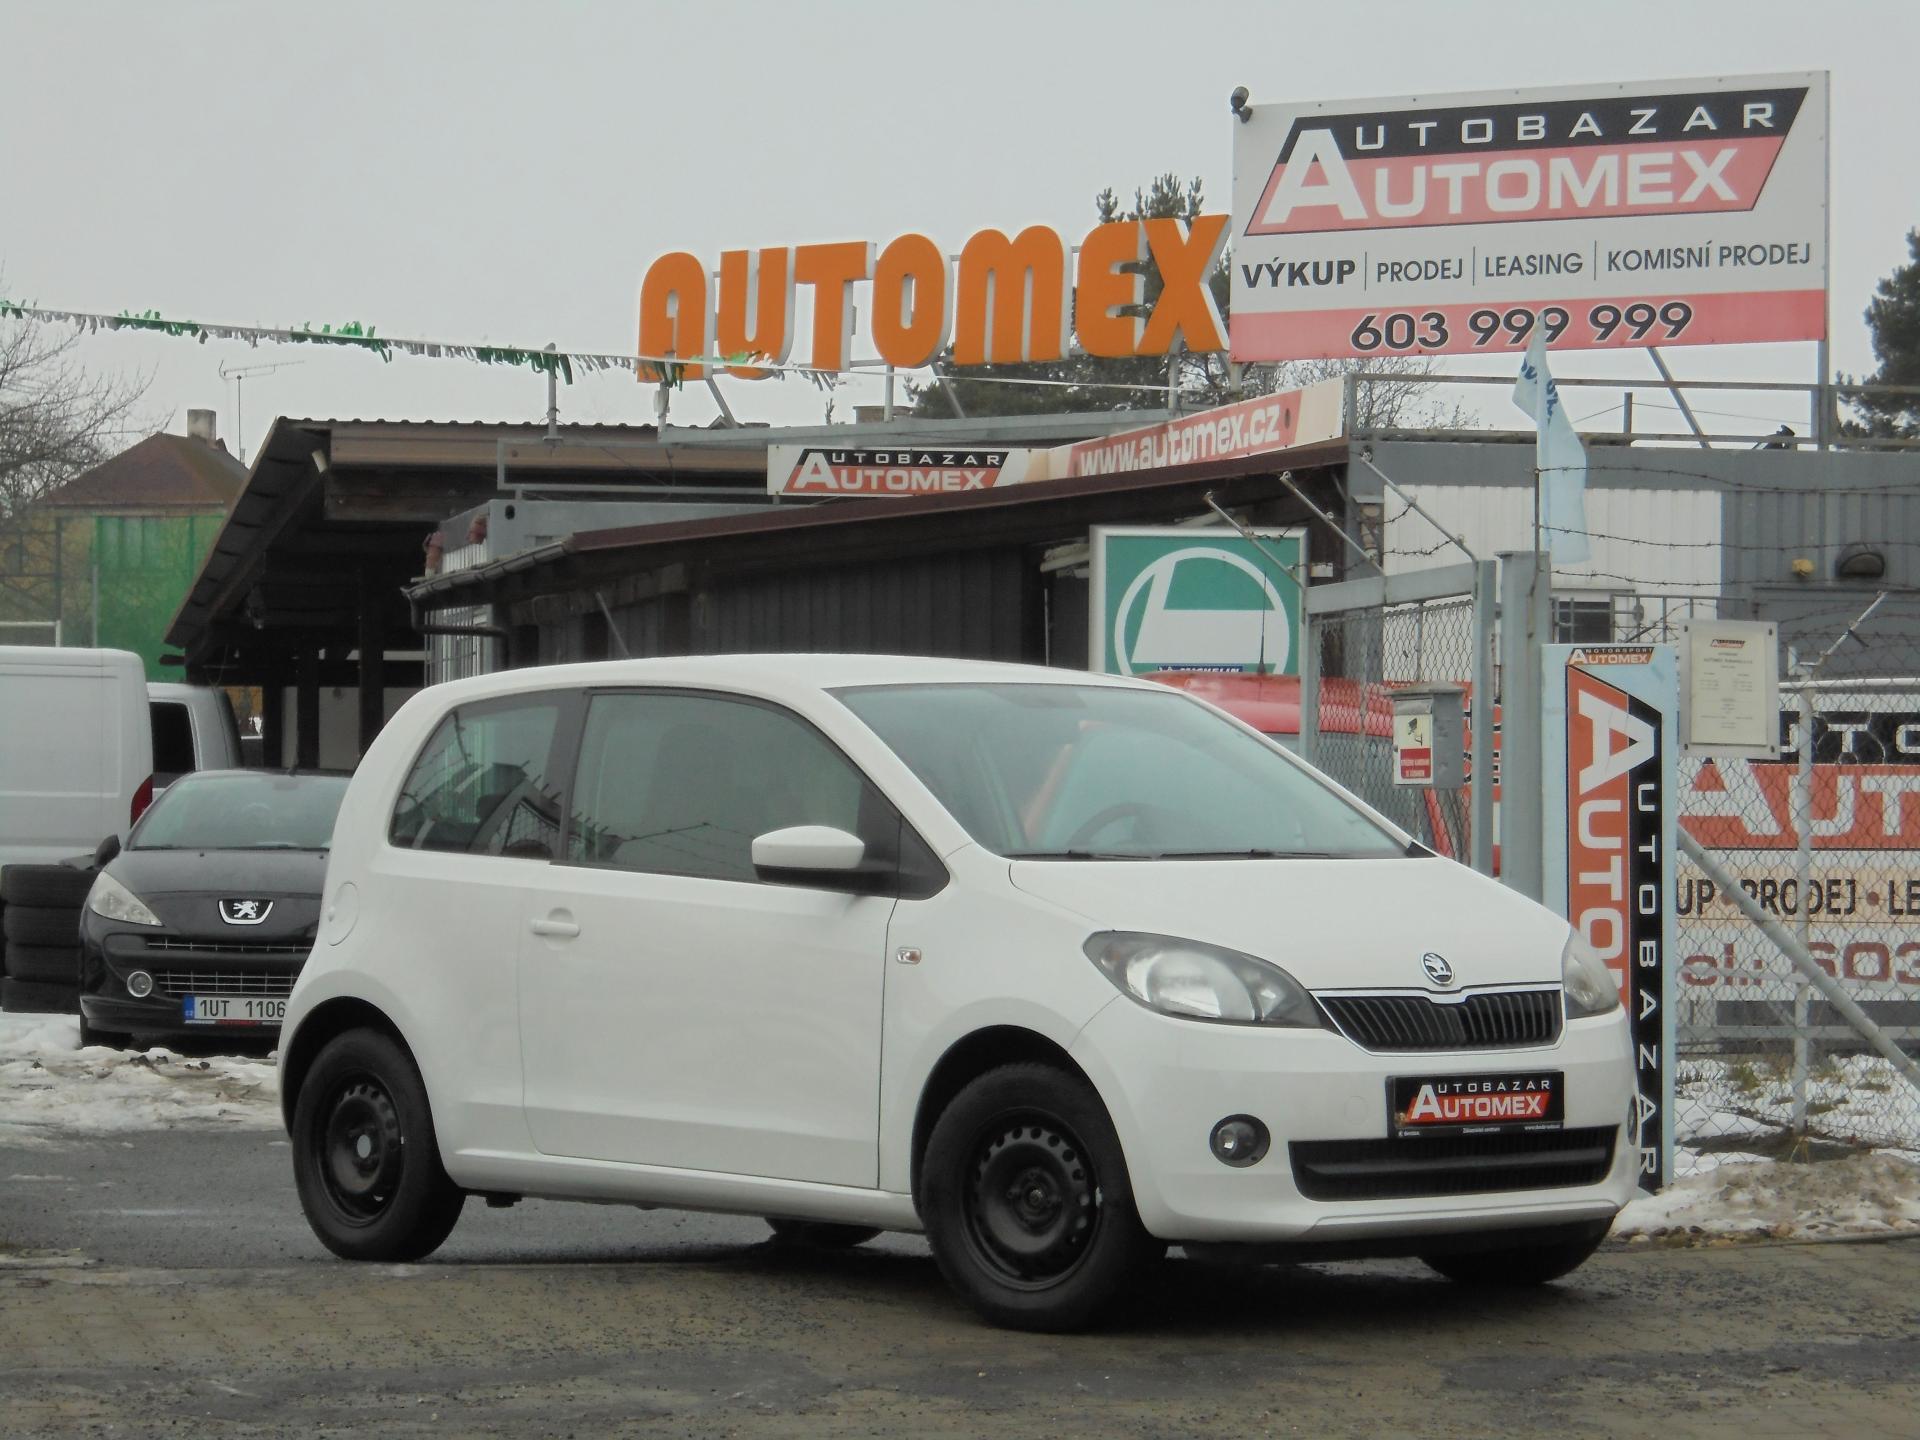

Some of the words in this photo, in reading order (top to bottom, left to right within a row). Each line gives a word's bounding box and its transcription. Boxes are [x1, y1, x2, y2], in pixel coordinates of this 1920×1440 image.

[1260, 128, 1738, 225] AUTOMEX
[1241, 256, 1356, 289] VÝKUP
[1377, 258, 1464, 282] PRODEJ
[1485, 252, 1584, 277] LEASING
[1607, 240, 1713, 271] KOMISNÍ
[1719, 243, 1811, 266] PRODEJ
[637, 214, 1231, 383] AUTOMEX
[1350, 311, 1450, 351] 603
[1467, 306, 1571, 347] 999
[1588, 301, 1694, 341] 999
[1080, 404, 1281, 477] www.automex.cz
[792, 452, 987, 491] AUTOMEX
[1568, 648, 1649, 665] AUTOMEX
[1740, 879, 1856, 916] PRODEJ
[200, 999, 230, 1017] 1UT
[245, 1000, 286, 1018] 1106
[1411, 1084, 1542, 1120] AUTOMEX
